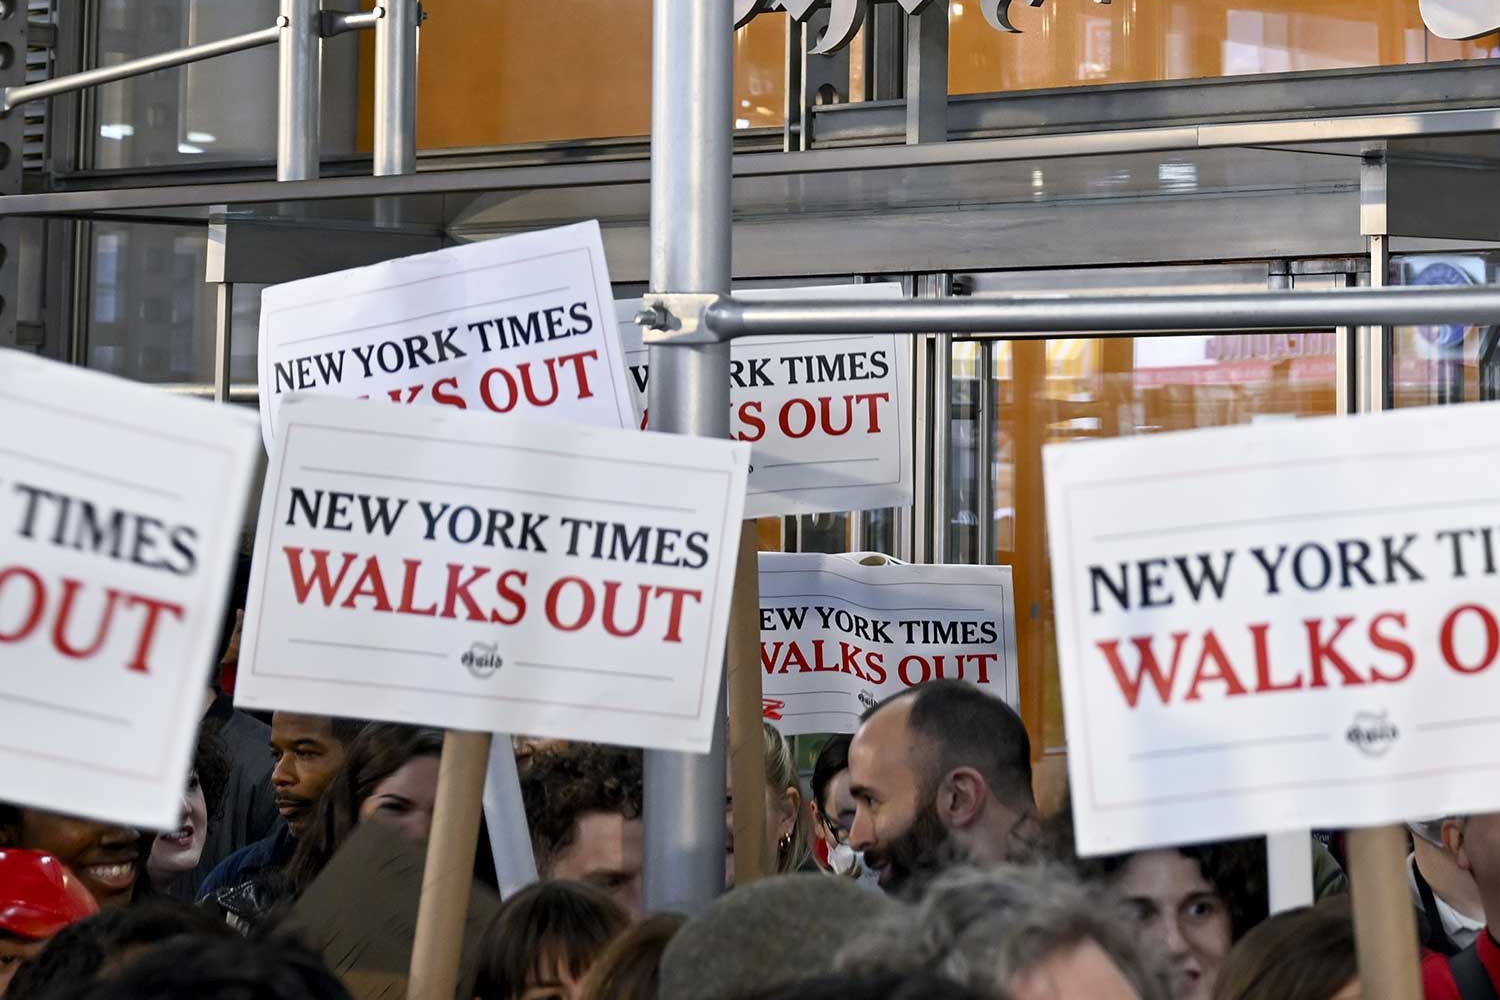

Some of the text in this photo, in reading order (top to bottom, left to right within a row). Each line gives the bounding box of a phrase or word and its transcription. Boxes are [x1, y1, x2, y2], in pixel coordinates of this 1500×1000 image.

[274, 350, 346, 394] NEW
[352, 325, 467, 378] YORK
[468, 301, 594, 352] TIMES
[480, 349, 599, 414] OUT
[730, 350, 890, 388] RK TIMES
[778, 392, 890, 440] OUT
[13, 483, 200, 577] TIMES
[286, 487, 711, 570] NEW YORK TIMES
[282, 546, 702, 643] WALKS OUT
[1088, 550, 1237, 614] NEW
[1249, 533, 1426, 596] YORK
[0, 566, 185, 675] OUT
[760, 606, 998, 644] EW YORK TIMES
[1094, 611, 1416, 709] WALKS
[897, 652, 998, 687] OUT
